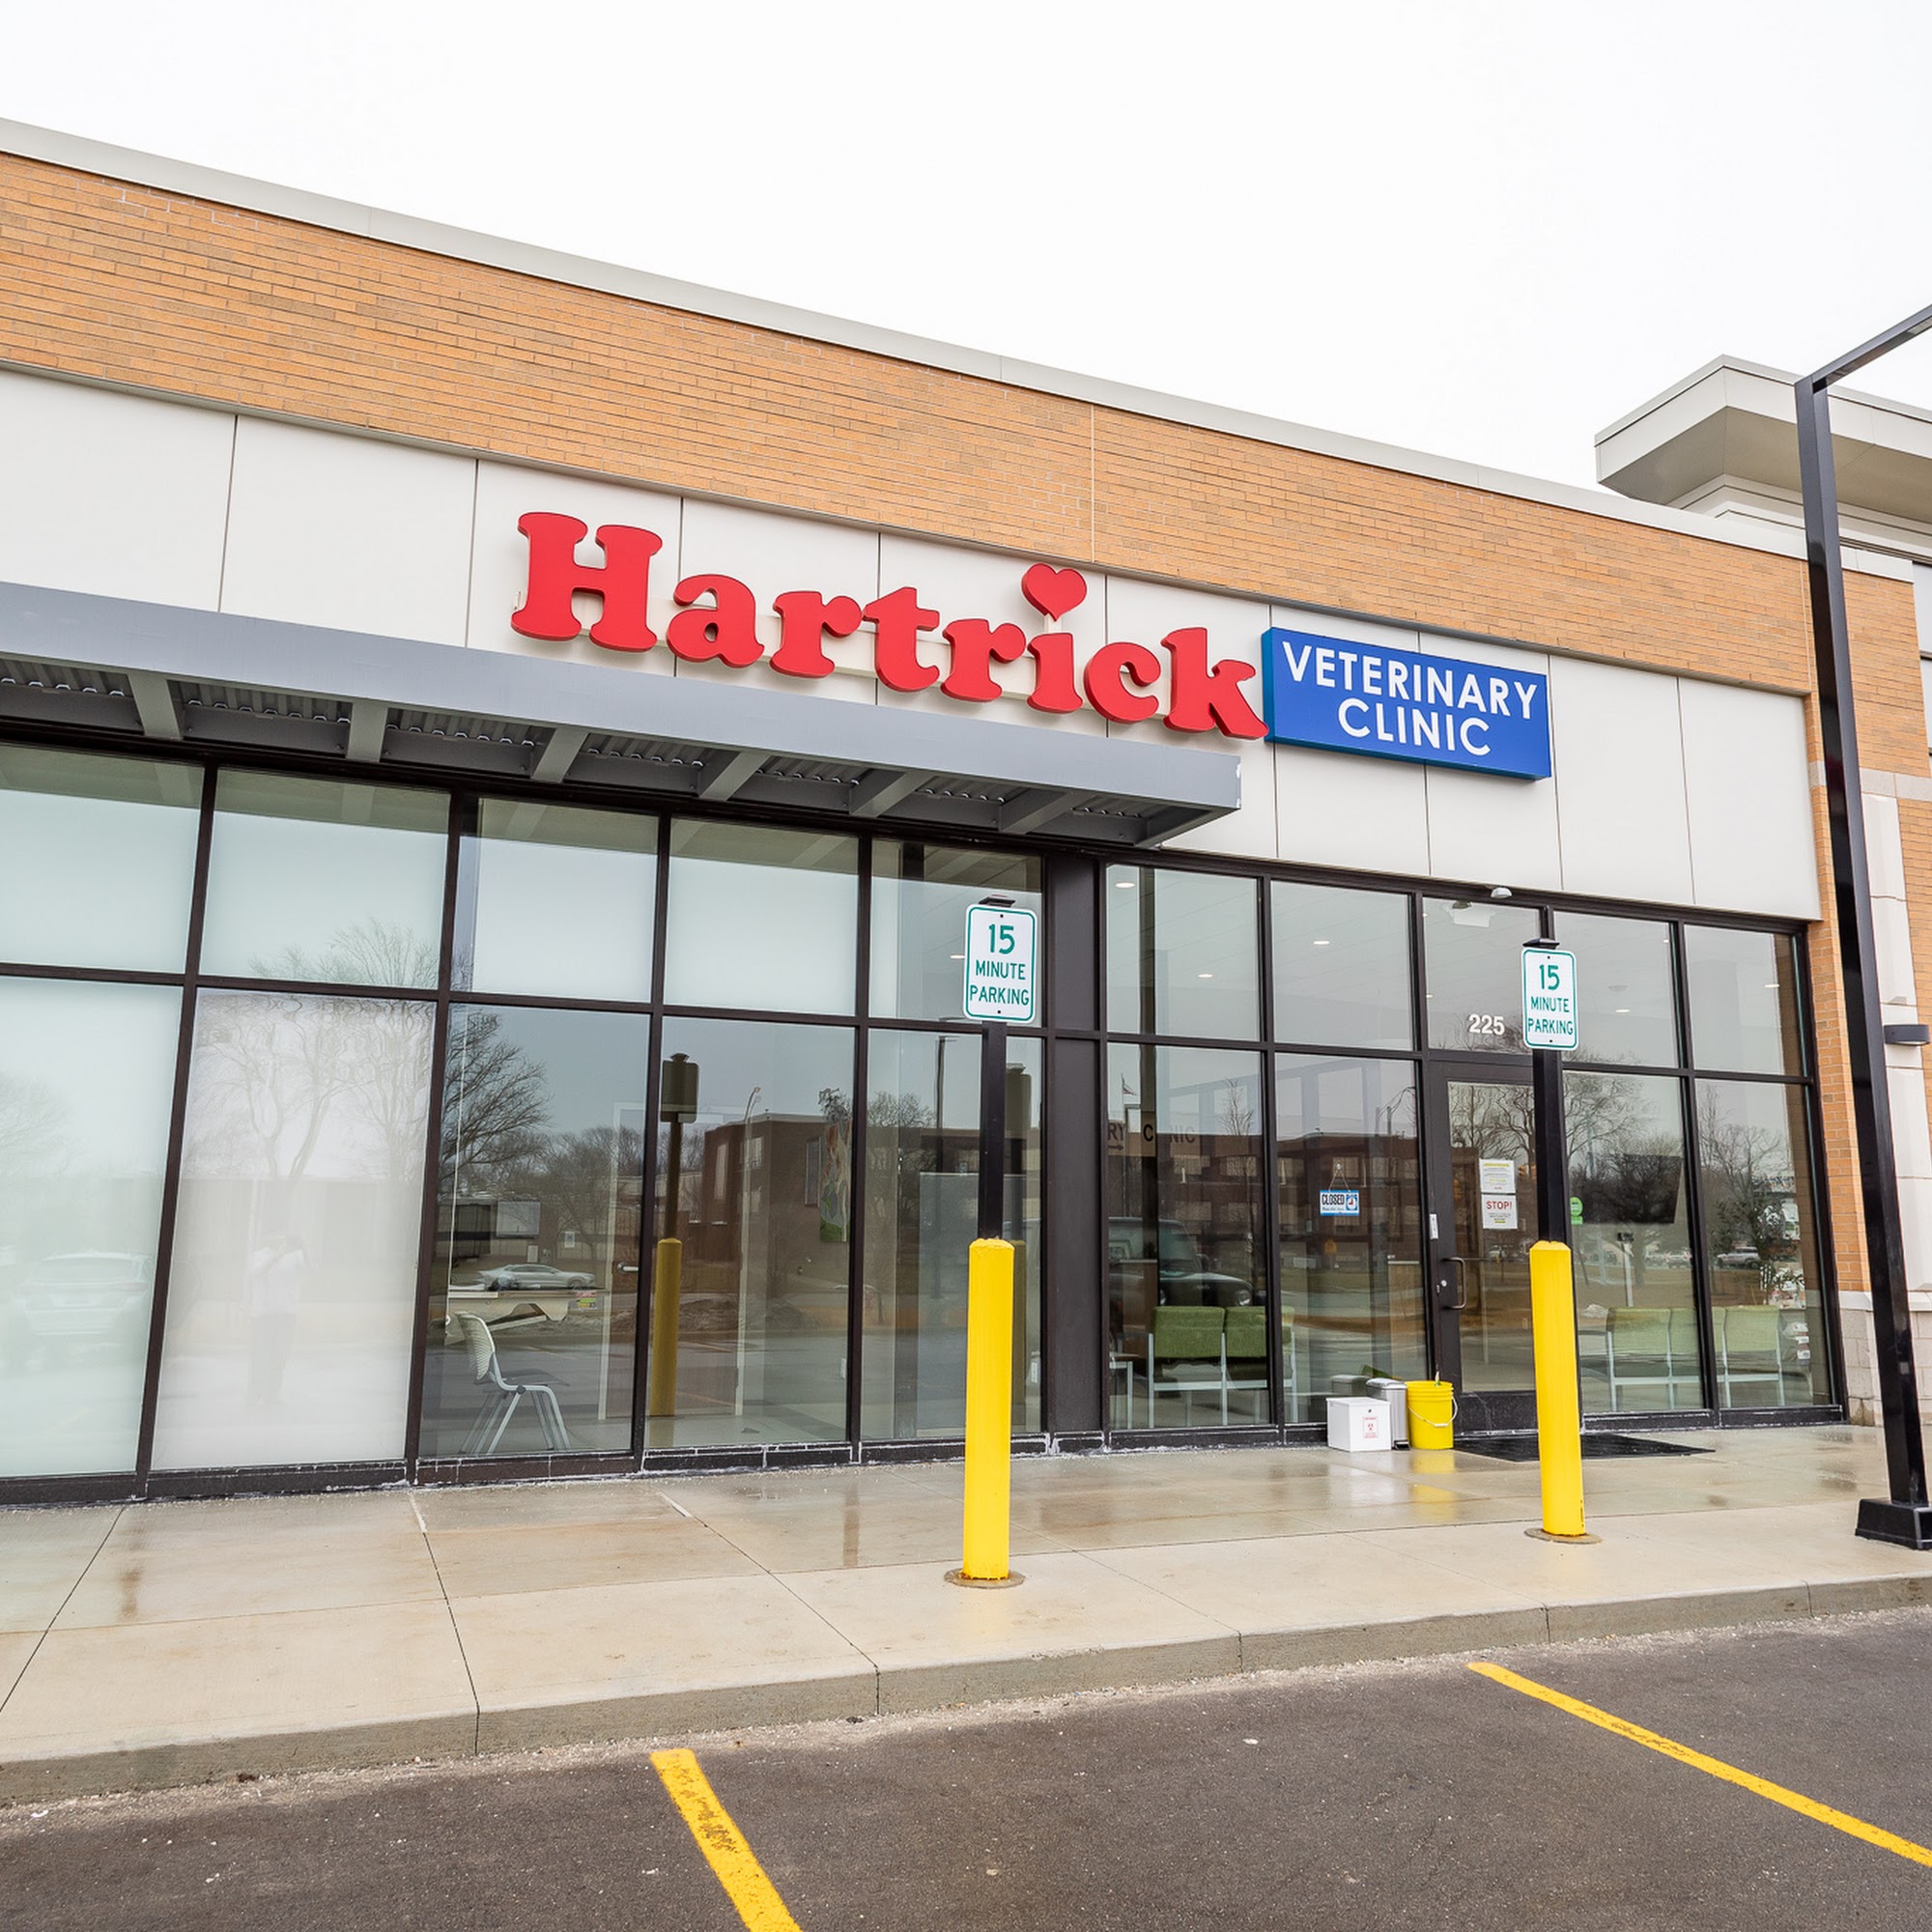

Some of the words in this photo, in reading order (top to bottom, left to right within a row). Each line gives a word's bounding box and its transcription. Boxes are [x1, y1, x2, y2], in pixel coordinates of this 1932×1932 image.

[511, 512, 1268, 740] Hartrick
[1282, 641, 1537, 720] VETERINARY
[1338, 697, 1491, 755] CLINIC
[988, 923, 1015, 954] 15
[976, 959, 1026, 980] MINUTE
[1539, 964, 1560, 991] 15
[970, 984, 1030, 1006] PARKING
[1530, 996, 1570, 1012] MINUTE
[1468, 1013, 1505, 1036] 225
[1527, 1018, 1574, 1036] PARKING
[1321, 1194, 1345, 1206] CLOSED
[1486, 1200, 1513, 1210] STOP!
